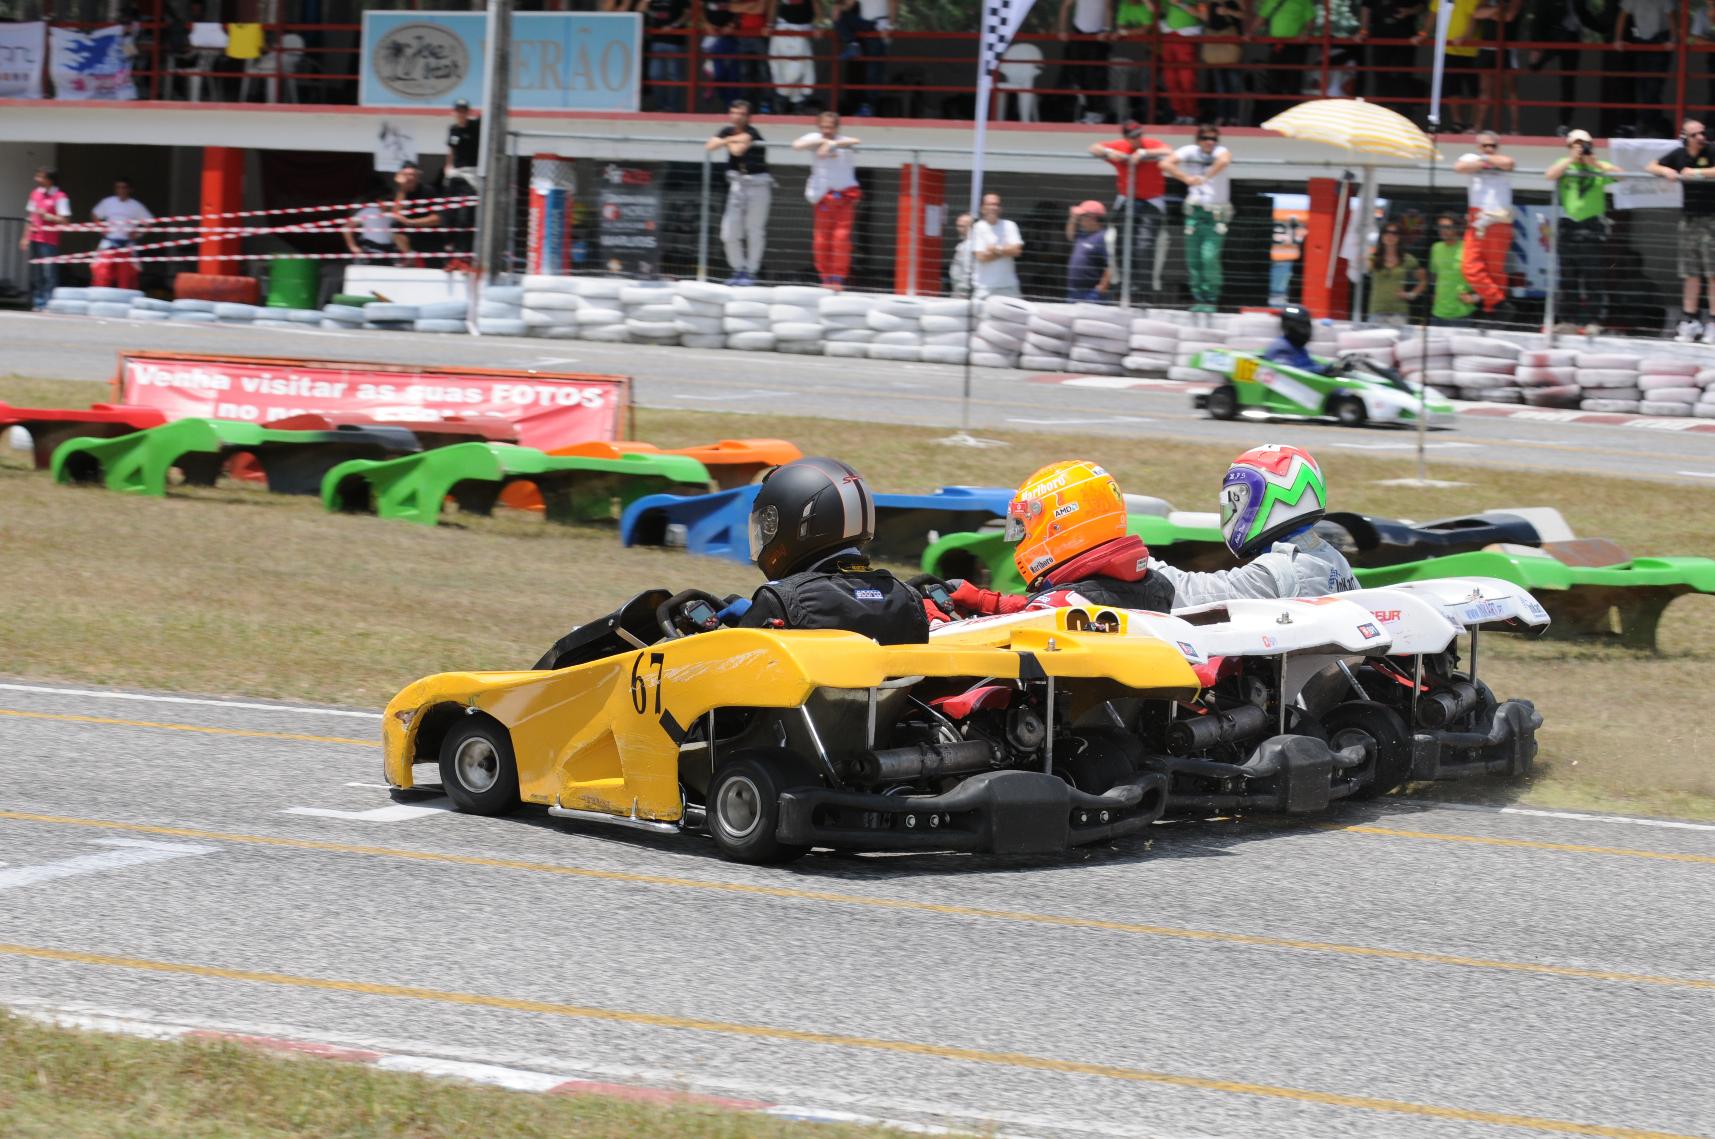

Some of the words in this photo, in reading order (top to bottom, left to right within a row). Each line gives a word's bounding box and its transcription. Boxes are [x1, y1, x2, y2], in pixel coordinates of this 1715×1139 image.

[480, 25, 632, 93] ERÃO
[133, 365, 231, 391] Venha
[241, 373, 346, 399] visitar
[356, 383, 396, 400] as
[404, 384, 483, 404] suas
[491, 384, 604, 409] FOTOS
[217, 402, 259, 420] no
[1020, 474, 1067, 501] Marlboro
[1029, 556, 1055, 576] Marlboro
[630, 650, 665, 715] 67
